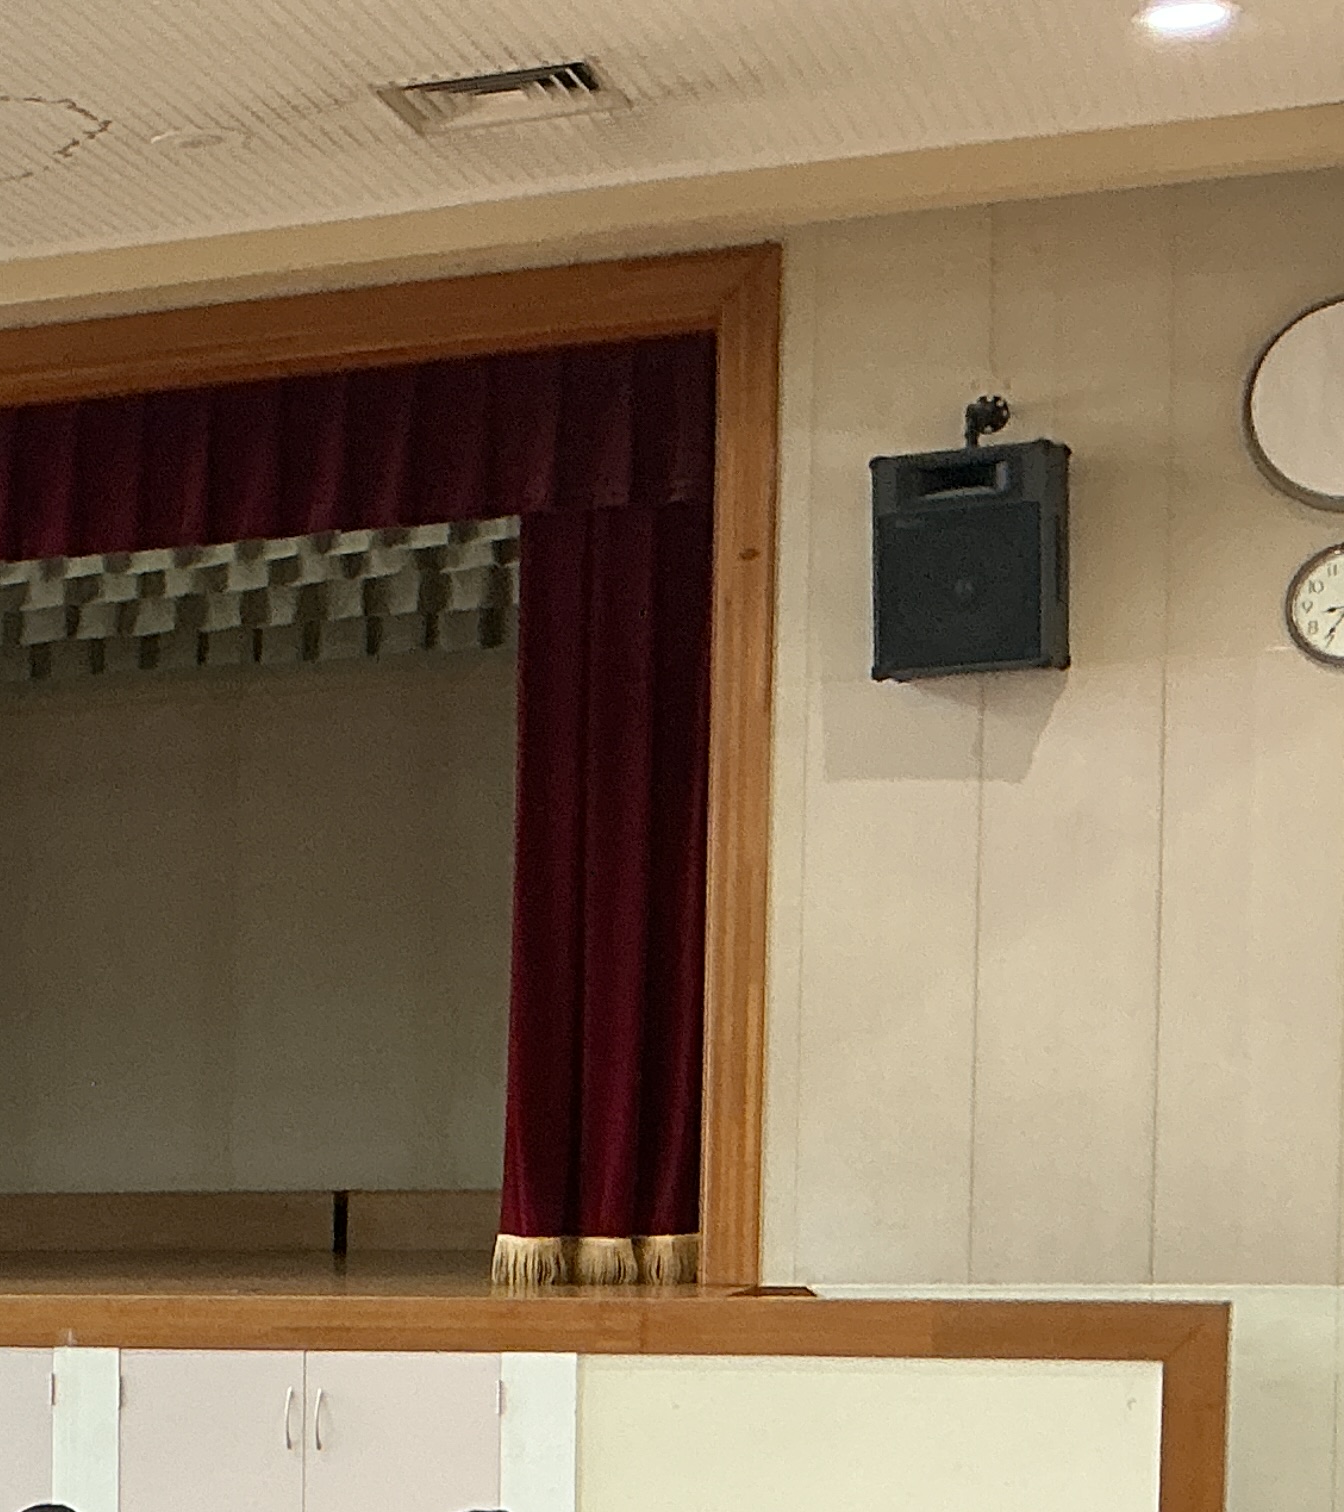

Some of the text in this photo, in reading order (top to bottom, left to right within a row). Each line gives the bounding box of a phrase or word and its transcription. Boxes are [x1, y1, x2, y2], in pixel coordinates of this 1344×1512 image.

[1327, 564, 1337, 576] 11
[1308, 579, 1324, 593] 10
[1302, 601, 1313, 614] 9
